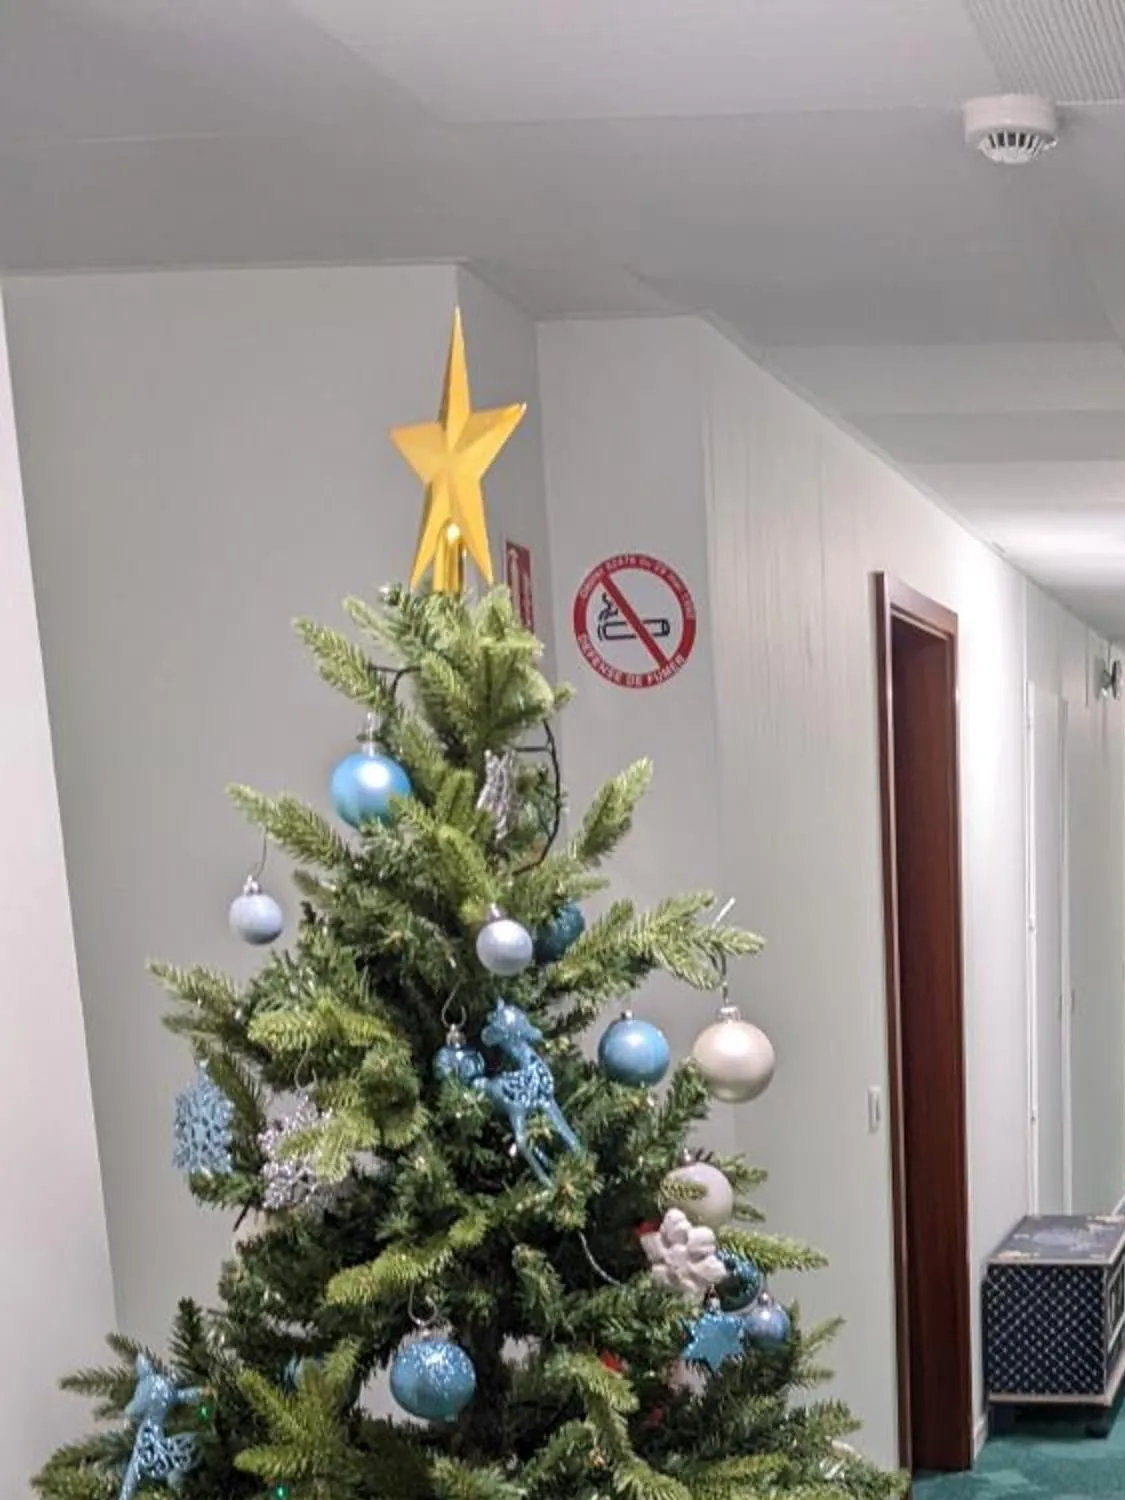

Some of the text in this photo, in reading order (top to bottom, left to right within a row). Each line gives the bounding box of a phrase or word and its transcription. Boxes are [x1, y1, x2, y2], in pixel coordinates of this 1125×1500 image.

[577, 633, 685, 688] DEFENSE DE FUMER
